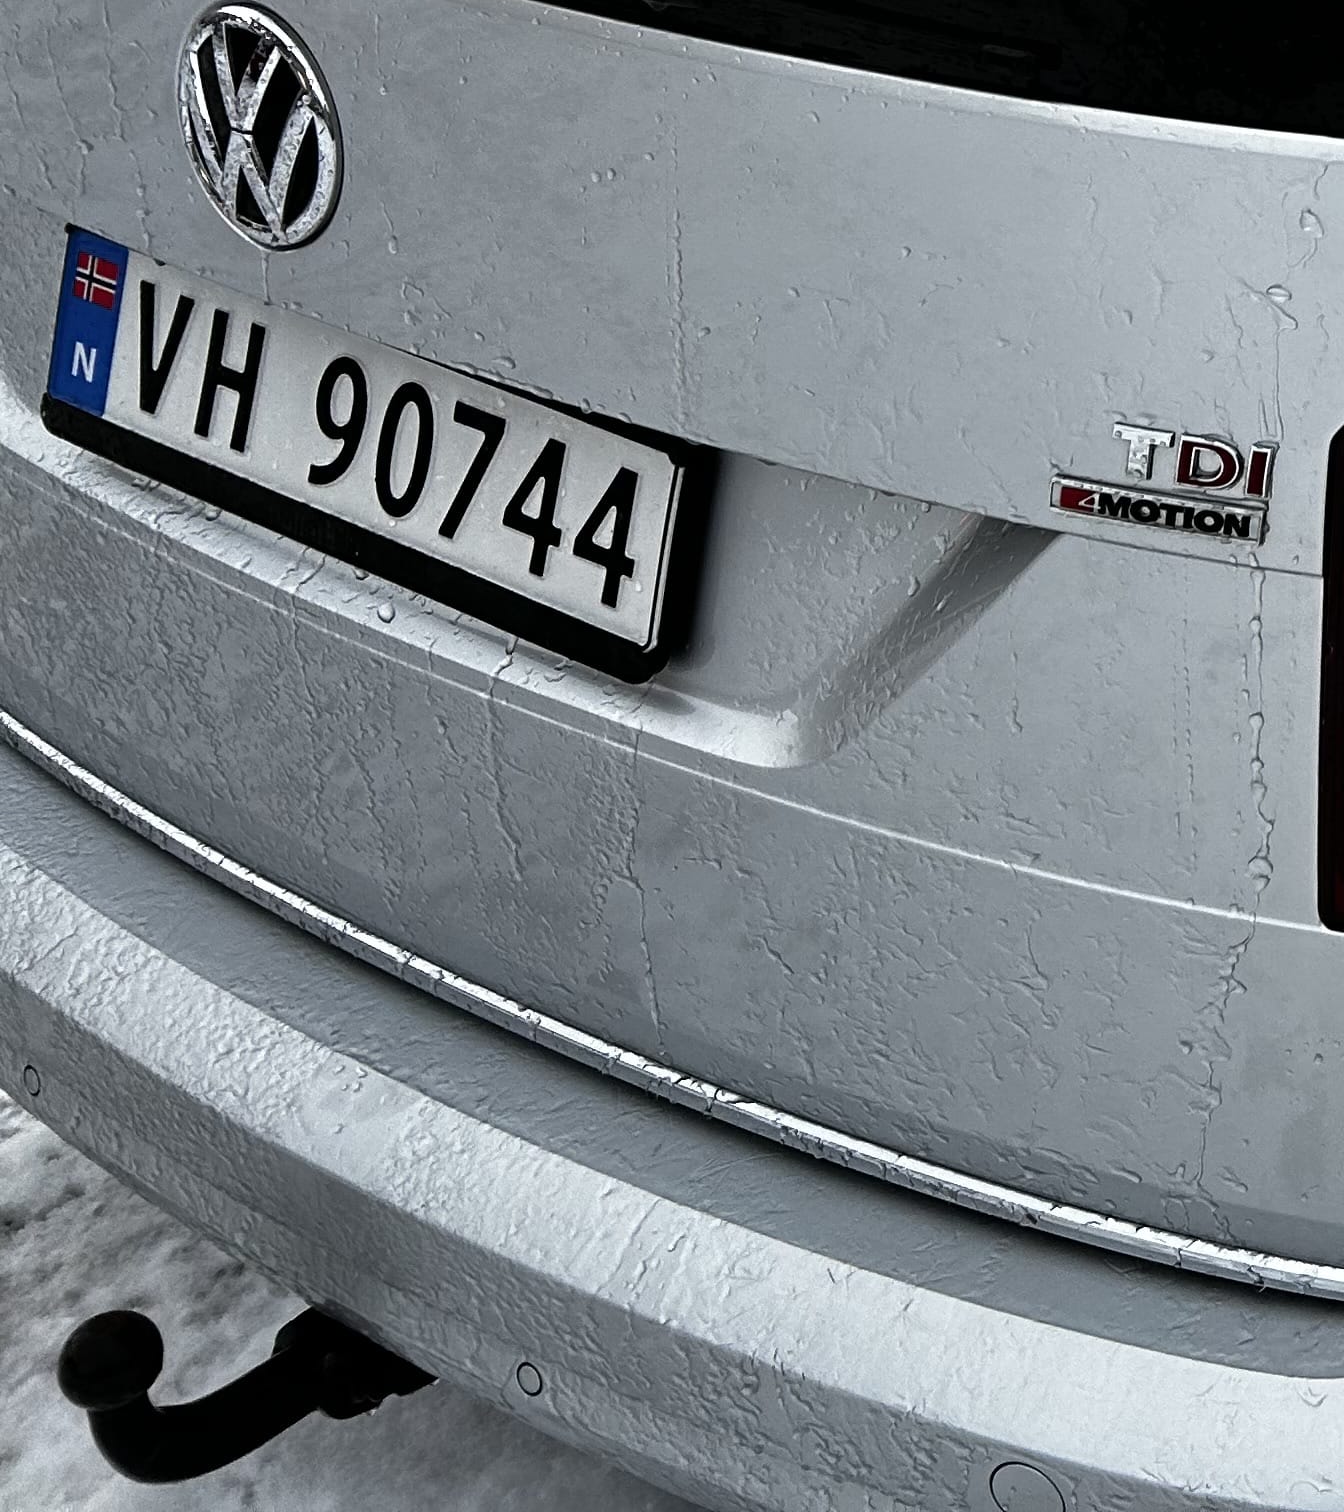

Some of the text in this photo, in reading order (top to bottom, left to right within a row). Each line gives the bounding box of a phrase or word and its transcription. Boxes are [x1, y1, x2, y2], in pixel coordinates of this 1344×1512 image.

[71, 341, 96, 385] N
[139, 279, 640, 609] VH 90744
[1111, 421, 1276, 499] TDI
[1074, 488, 1251, 538] 4MOTION
